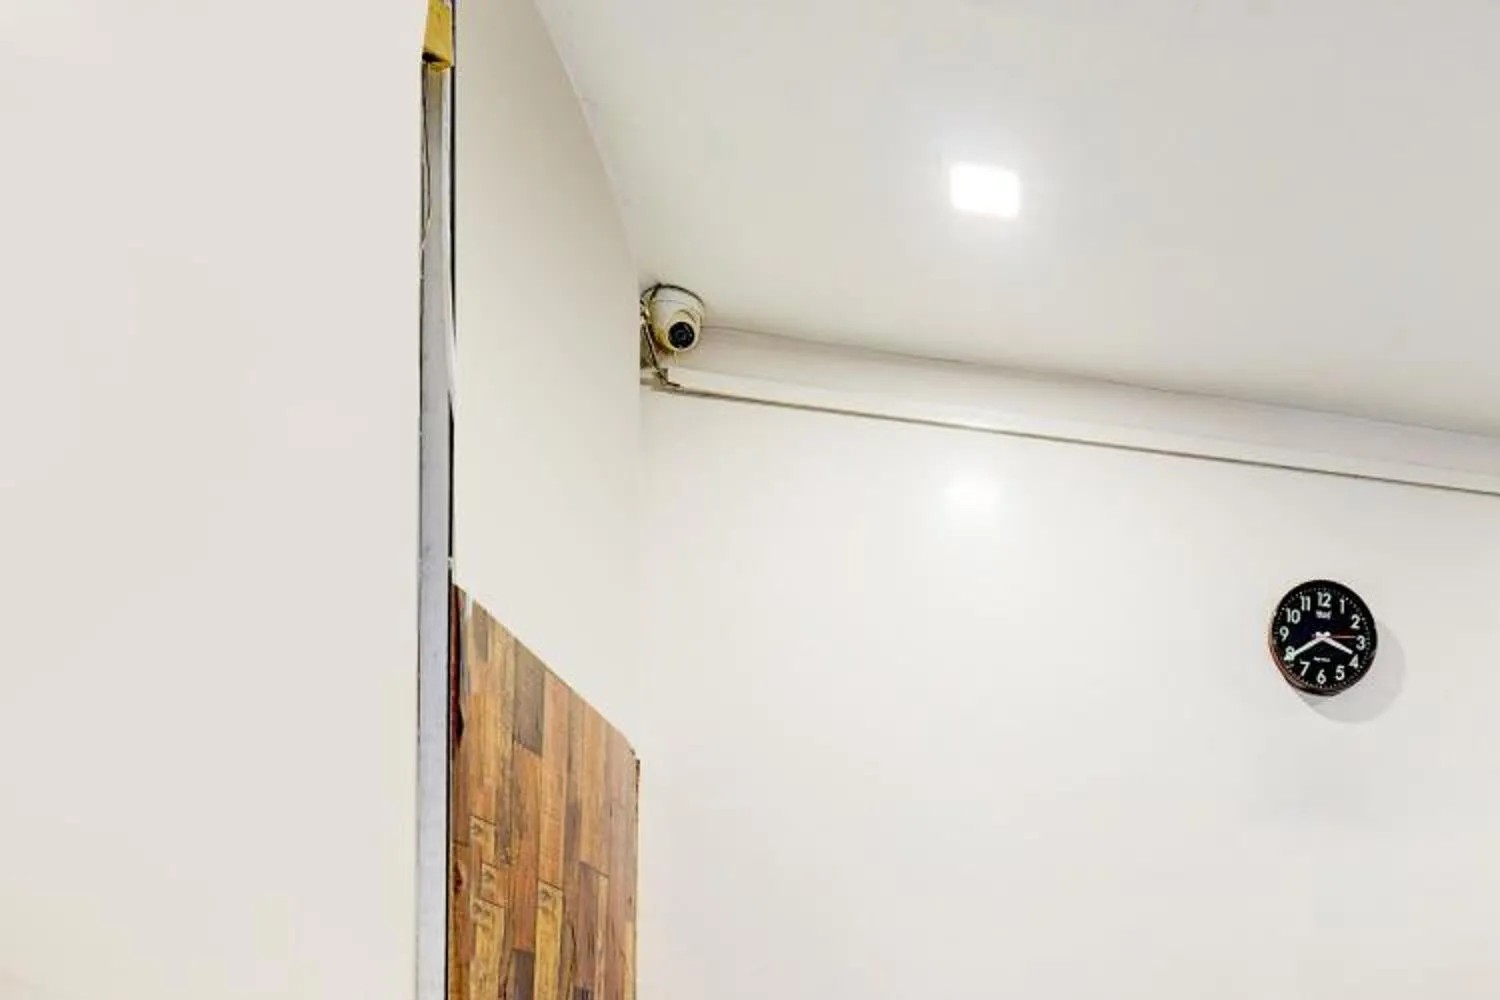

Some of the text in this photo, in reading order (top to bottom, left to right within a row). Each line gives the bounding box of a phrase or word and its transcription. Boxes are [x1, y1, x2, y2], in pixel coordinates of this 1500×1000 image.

[1300, 595, 1311, 611] 11
[1317, 591, 1332, 608] 12
[1339, 598, 1345, 614] 1
[1286, 607, 1301, 624] 10
[1350, 613, 1361, 630] 2
[1279, 625, 1289, 642] 9
[1356, 635, 1366, 651] 3
[1285, 645, 1296, 661] 8
[1300, 660, 1311, 677] 7
[1348, 654, 1359, 669] 4
[1316, 669, 1327, 684] 6
[1335, 665, 1345, 681] 5
